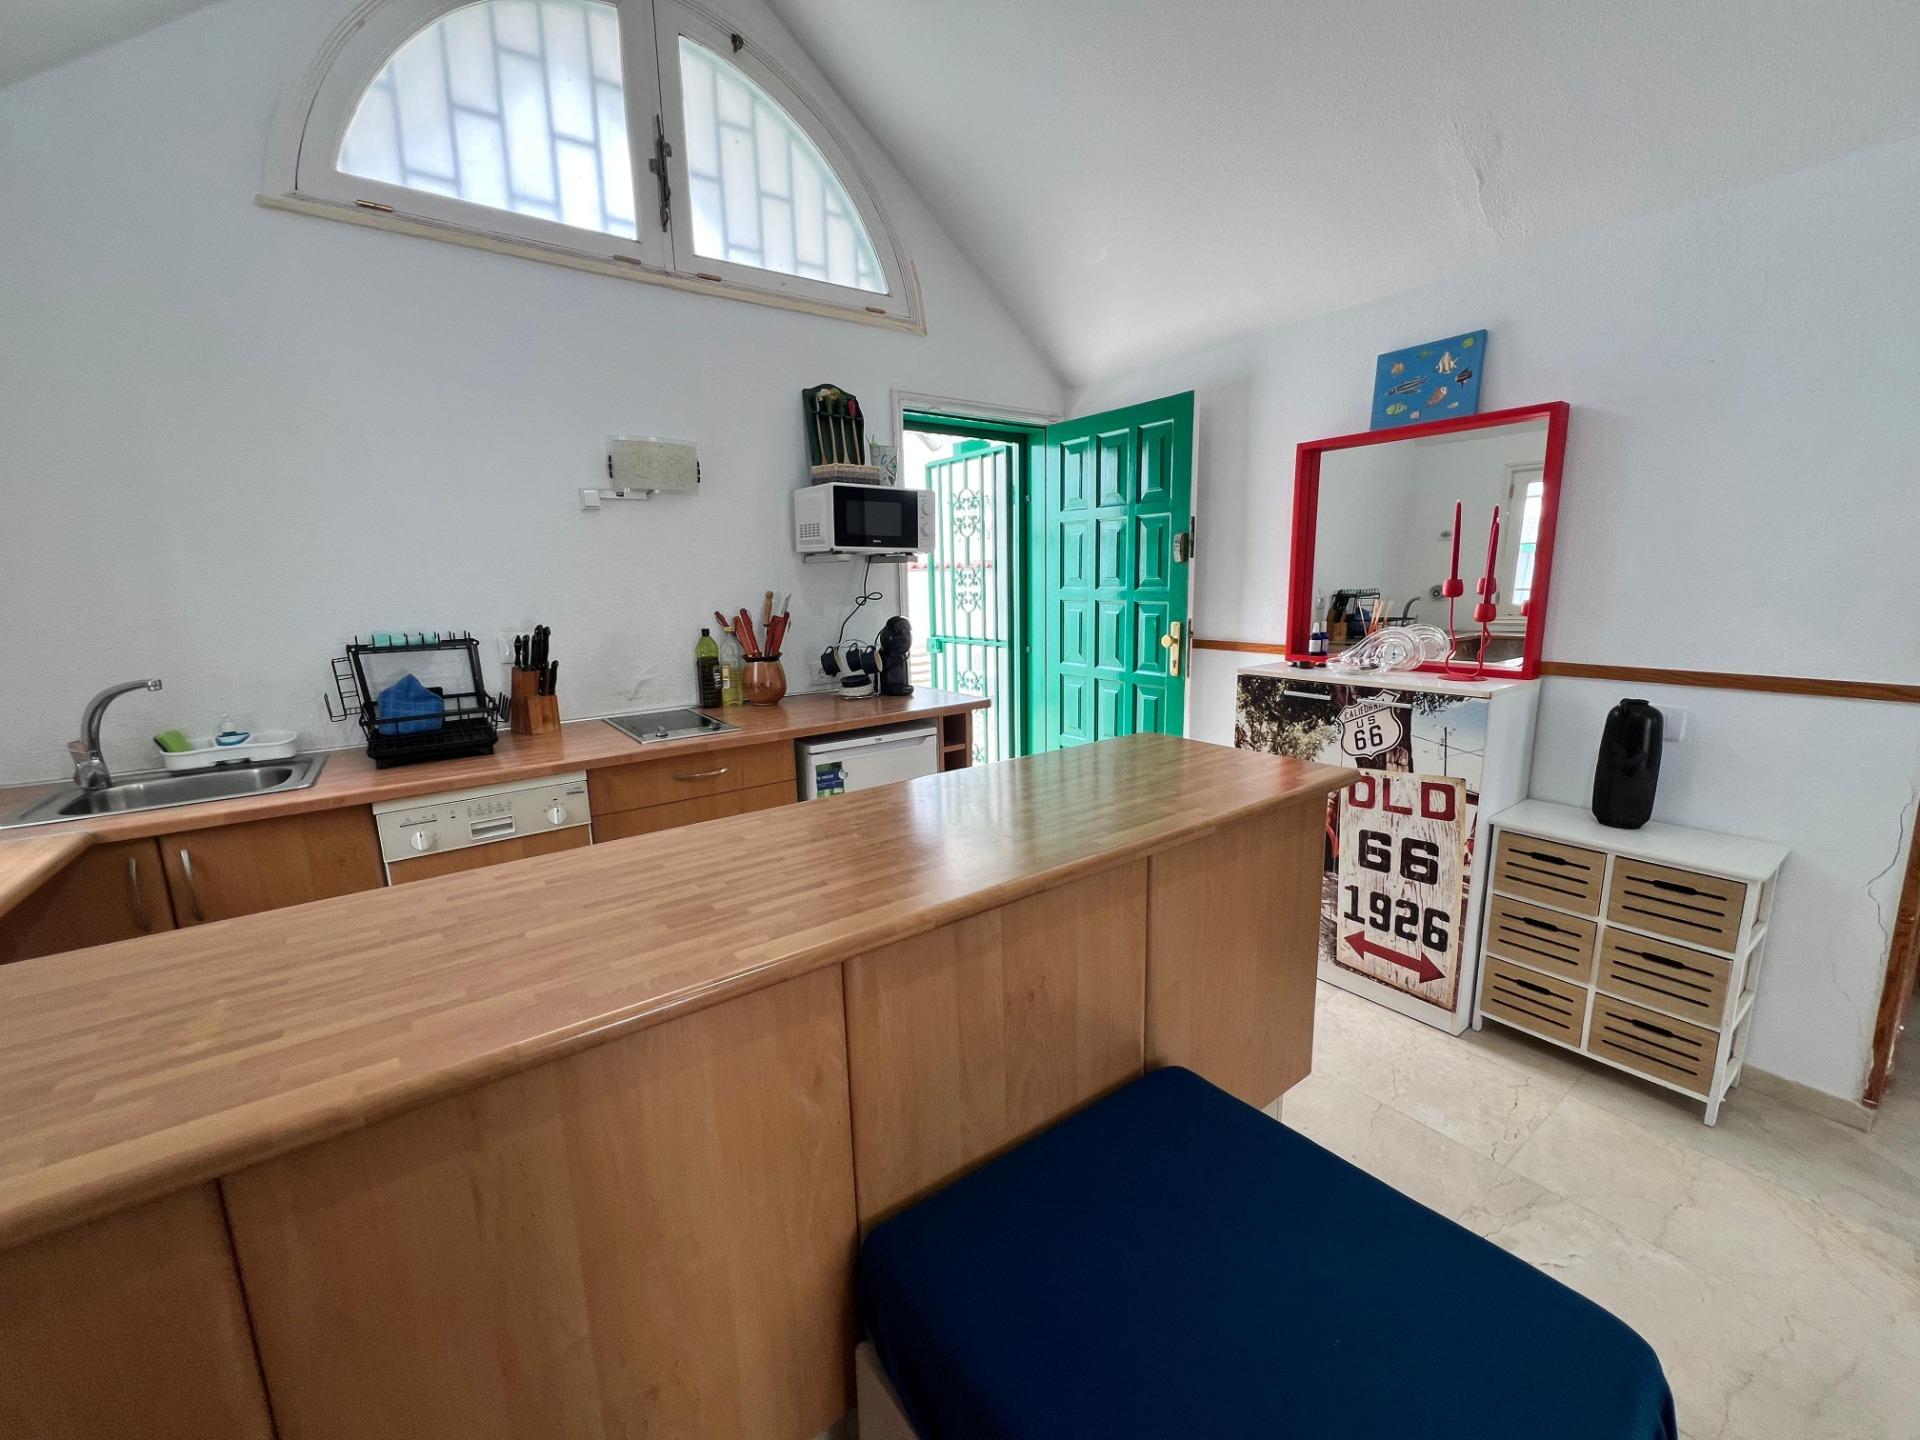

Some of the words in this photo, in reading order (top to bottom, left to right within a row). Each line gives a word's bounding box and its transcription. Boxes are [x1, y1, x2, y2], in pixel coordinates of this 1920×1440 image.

[1344, 703, 1384, 720] CALIFORN
[1354, 724, 1383, 751] 66
[1348, 775, 1457, 822] OLD
[1358, 829, 1440, 886] 66
[1343, 885, 1451, 953] 1926
